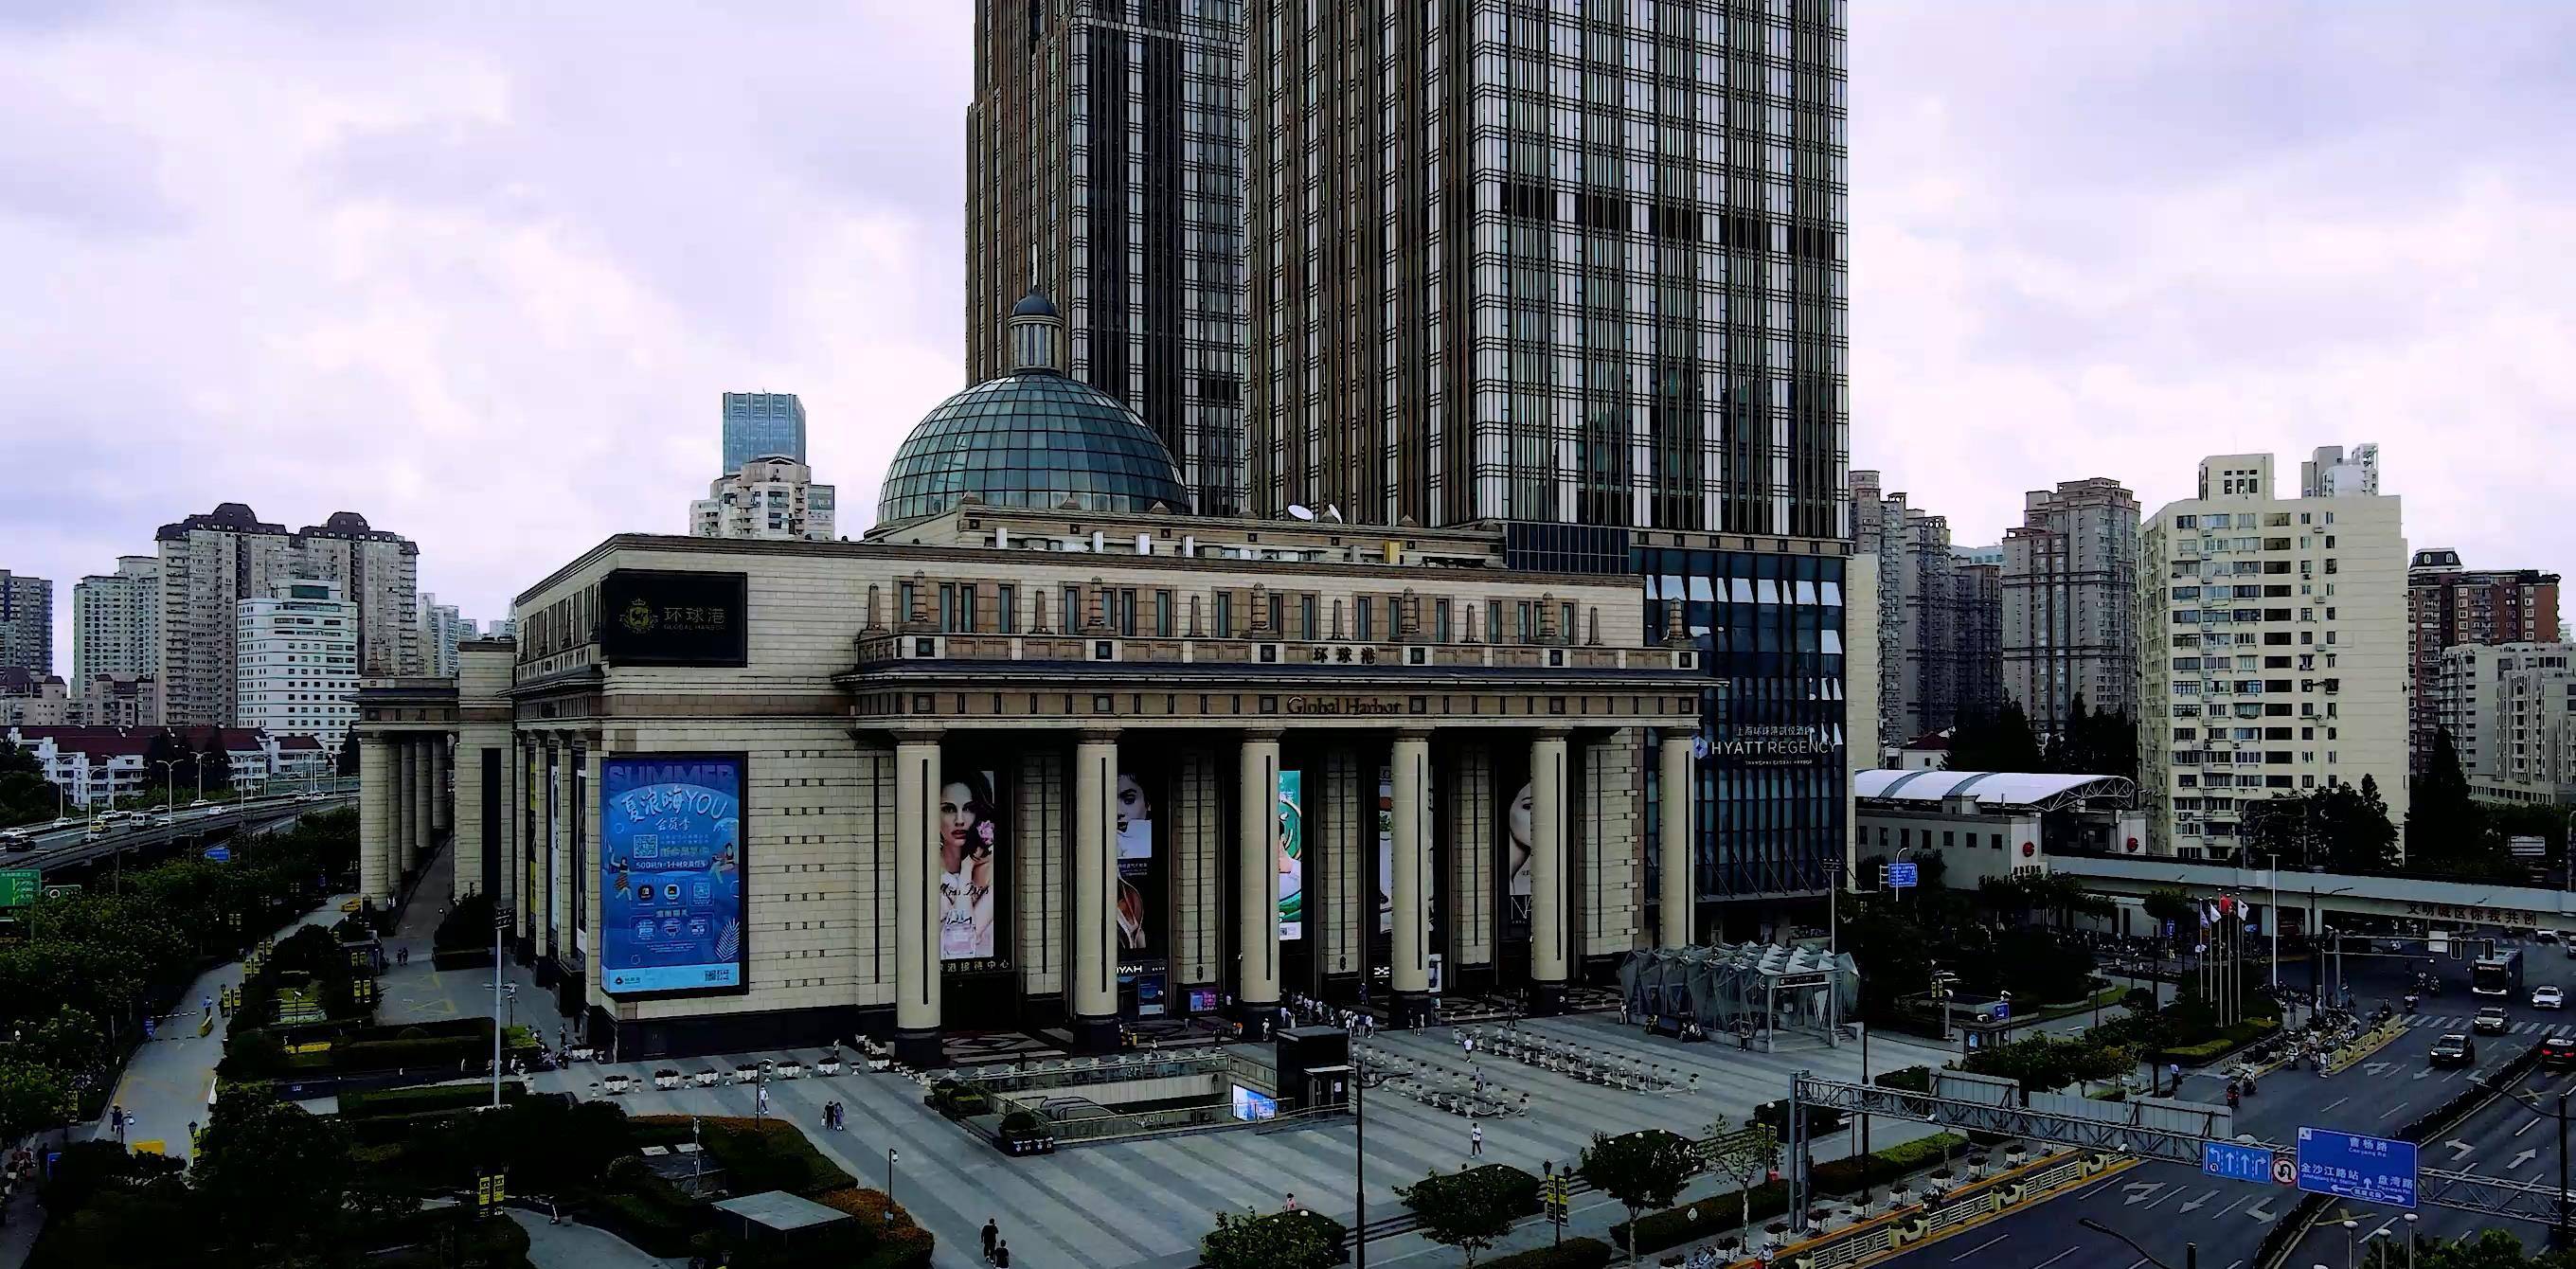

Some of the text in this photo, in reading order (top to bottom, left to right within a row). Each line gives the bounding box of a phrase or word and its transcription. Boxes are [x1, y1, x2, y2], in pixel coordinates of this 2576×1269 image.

[663, 607, 725, 624] 环球港
[1313, 646, 1376, 664] 环球港
[1287, 696, 1402, 715] Global Harbor
[1711, 741, 1835, 755] HYATT REGENCY
[2349, 1136, 2388, 1153] 曹杨路
[2300, 1162, 2359, 1181] 金沙江路站
[2378, 1174, 2413, 1190] 盘湾路
